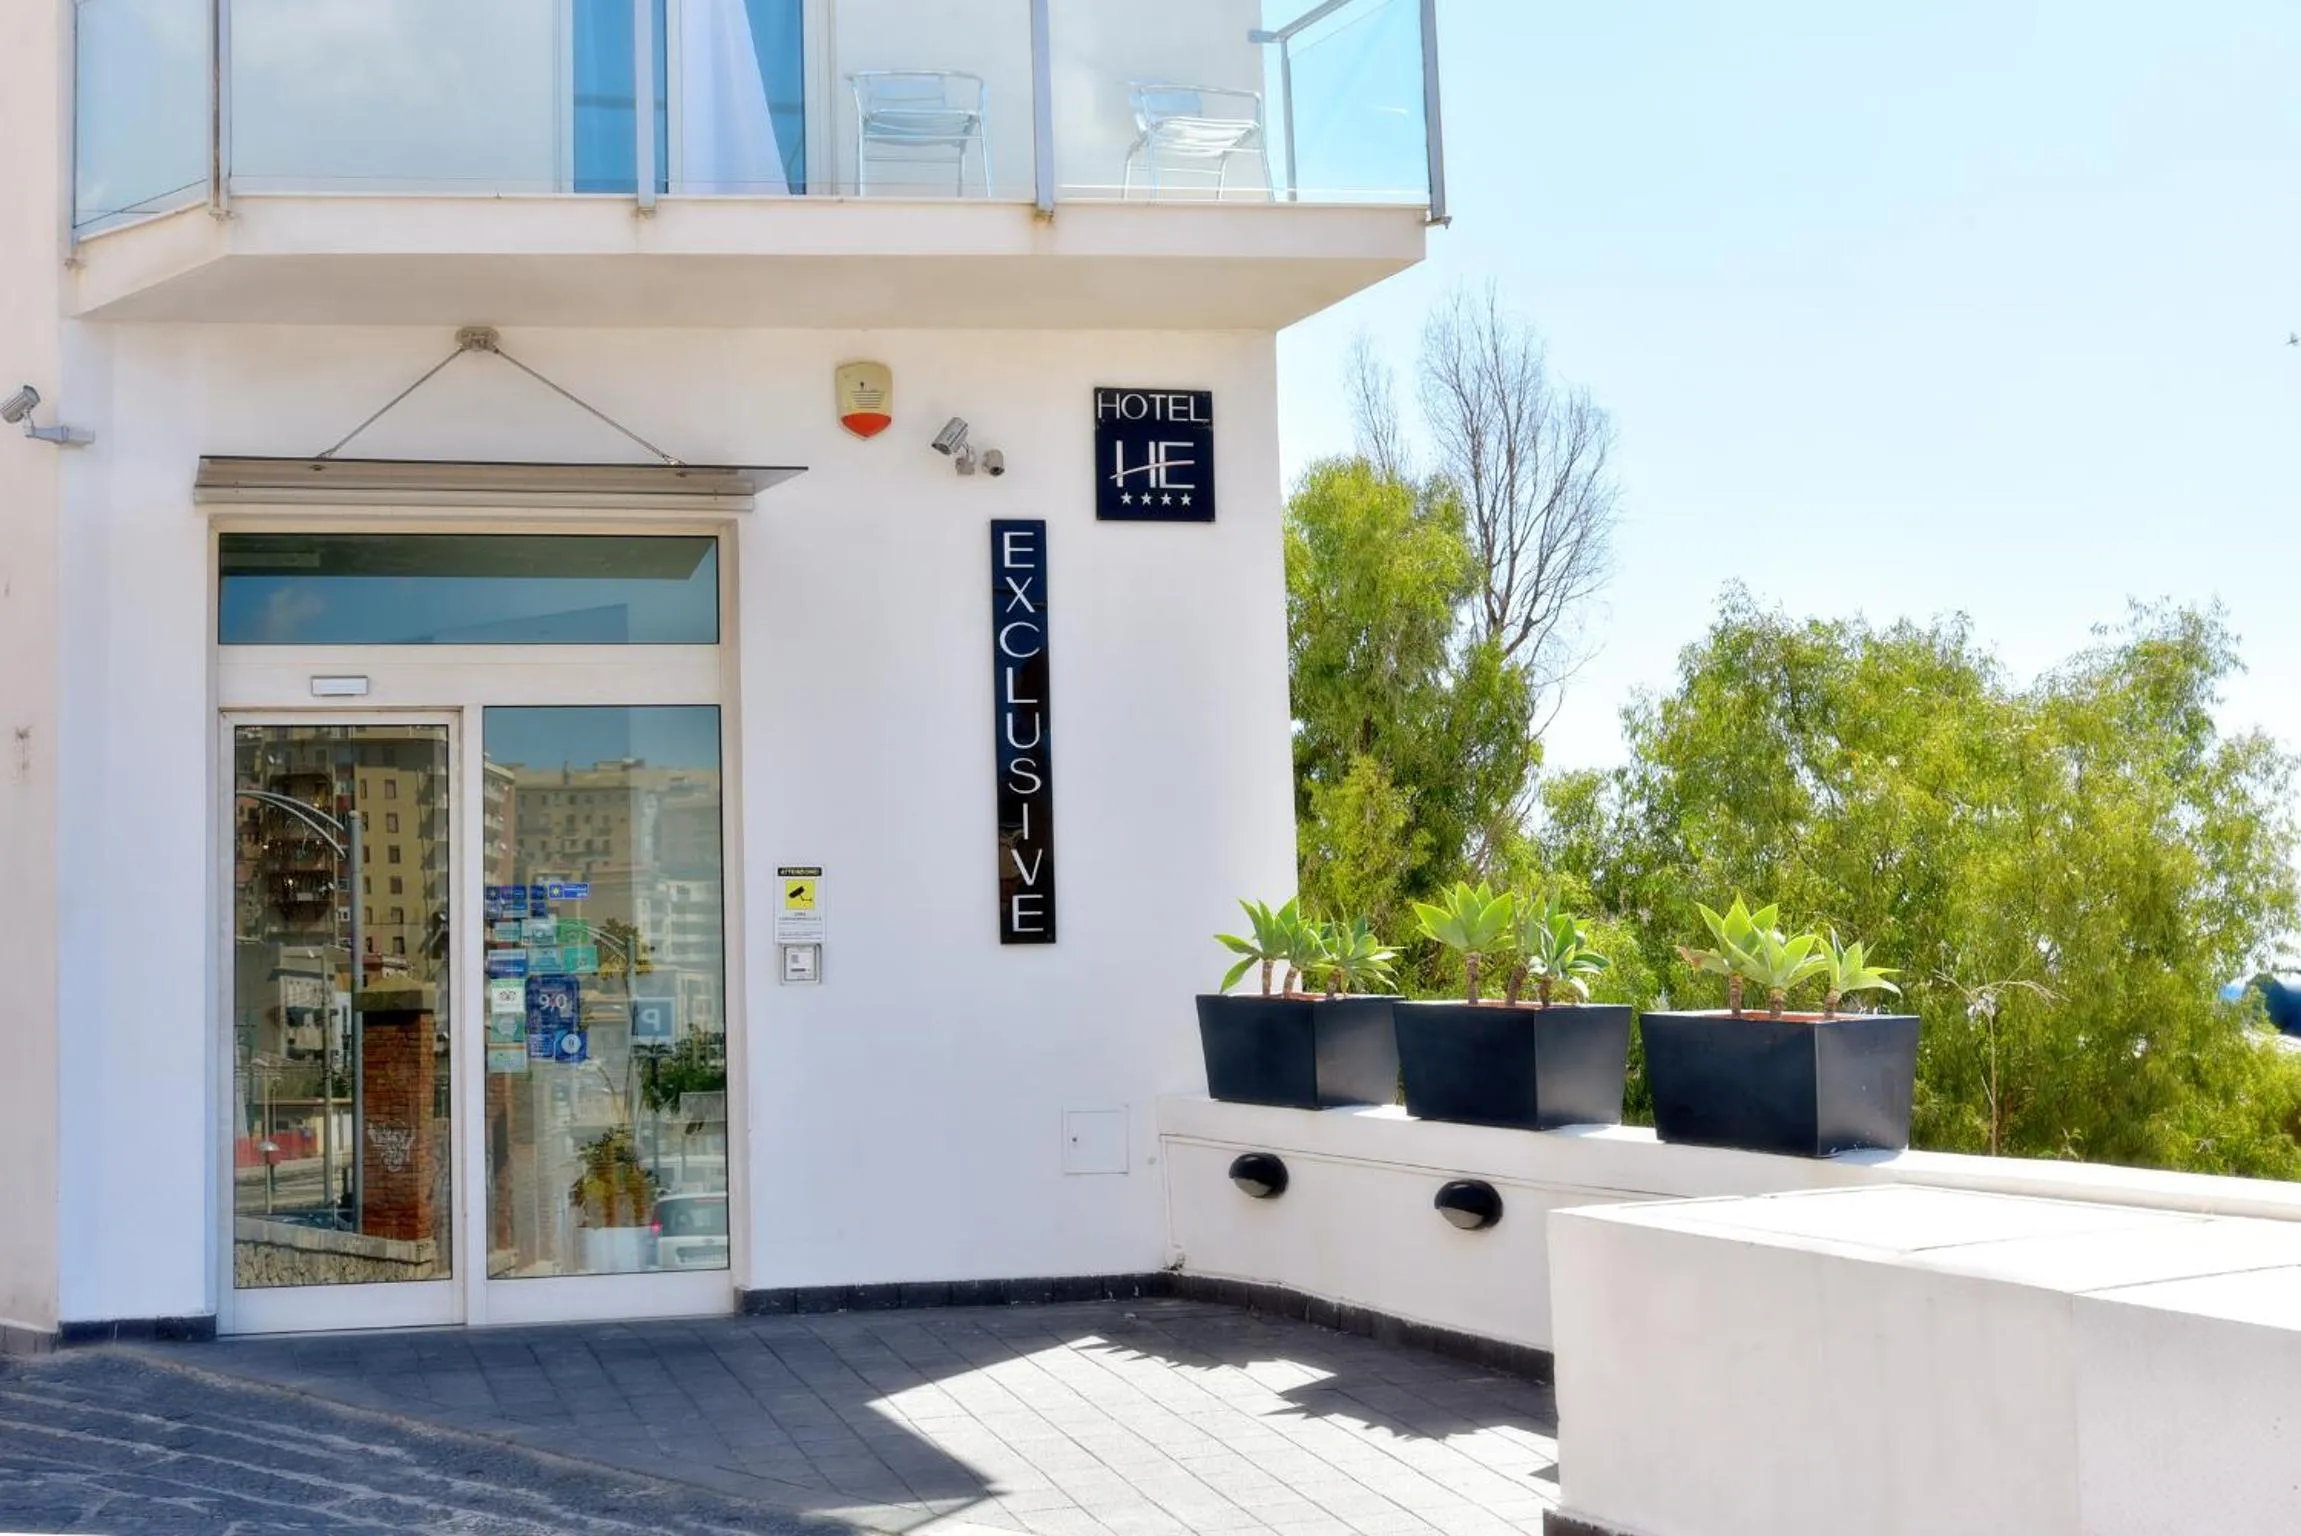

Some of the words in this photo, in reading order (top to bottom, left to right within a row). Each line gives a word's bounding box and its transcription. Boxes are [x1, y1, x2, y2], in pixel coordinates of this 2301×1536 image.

[1097, 393, 1210, 422] HOTEL
[1110, 440, 1195, 489] HE
[999, 531, 1044, 933] EXCLUSIVE
